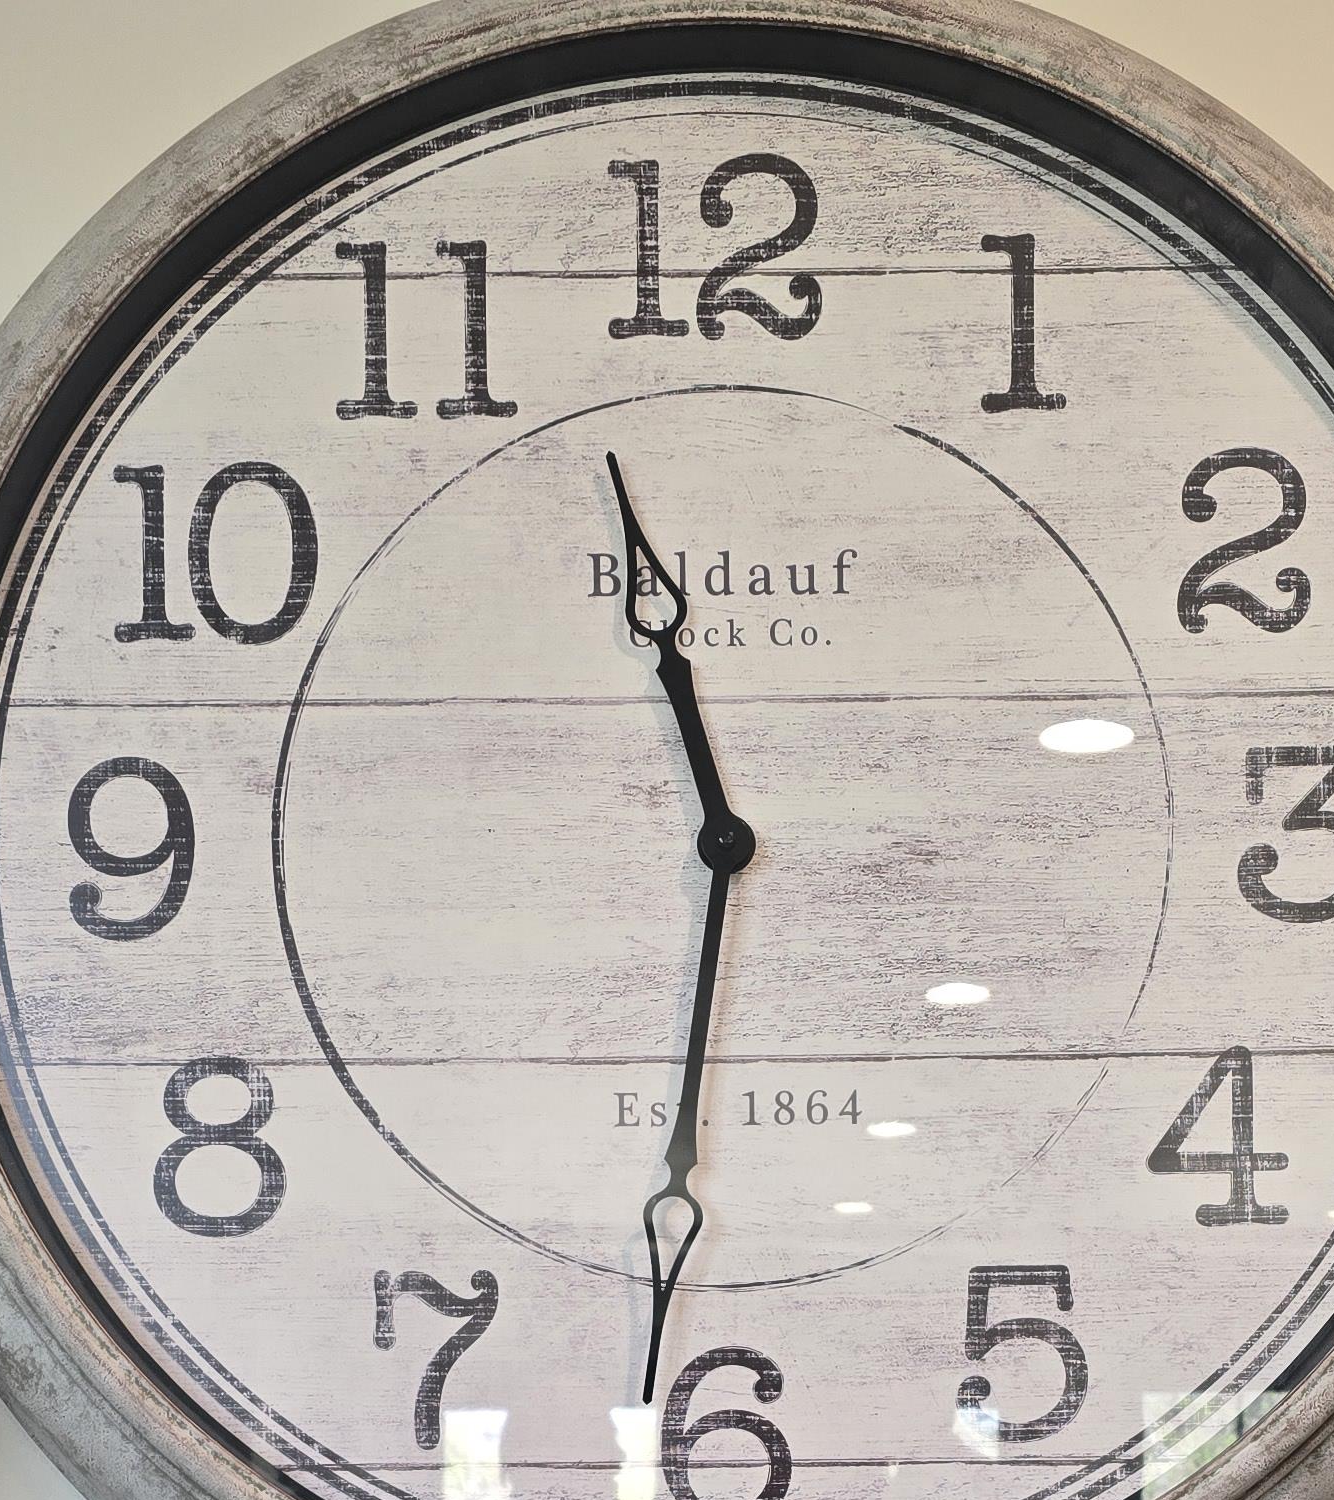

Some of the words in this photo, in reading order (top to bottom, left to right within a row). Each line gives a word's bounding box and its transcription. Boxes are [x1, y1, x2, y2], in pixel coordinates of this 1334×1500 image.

[335, 239, 518, 421] 11
[608, 153, 823, 340] 12
[980, 233, 1067, 413] 1
[113, 460, 319, 645] 10
[587, 548, 858, 598] Baldauf
[1177, 447, 1311, 634] 2
[769, 618, 832, 647] Co.
[68, 756, 196, 941] 9
[153, 1056, 287, 1238] 8
[613, 1091, 709, 1127] Es.
[741, 1088, 863, 1126] 1864
[1145, 1045, 1290, 1227] 4
[373, 1269, 498, 1451] 7
[955, 1264, 1090, 1443] 5
